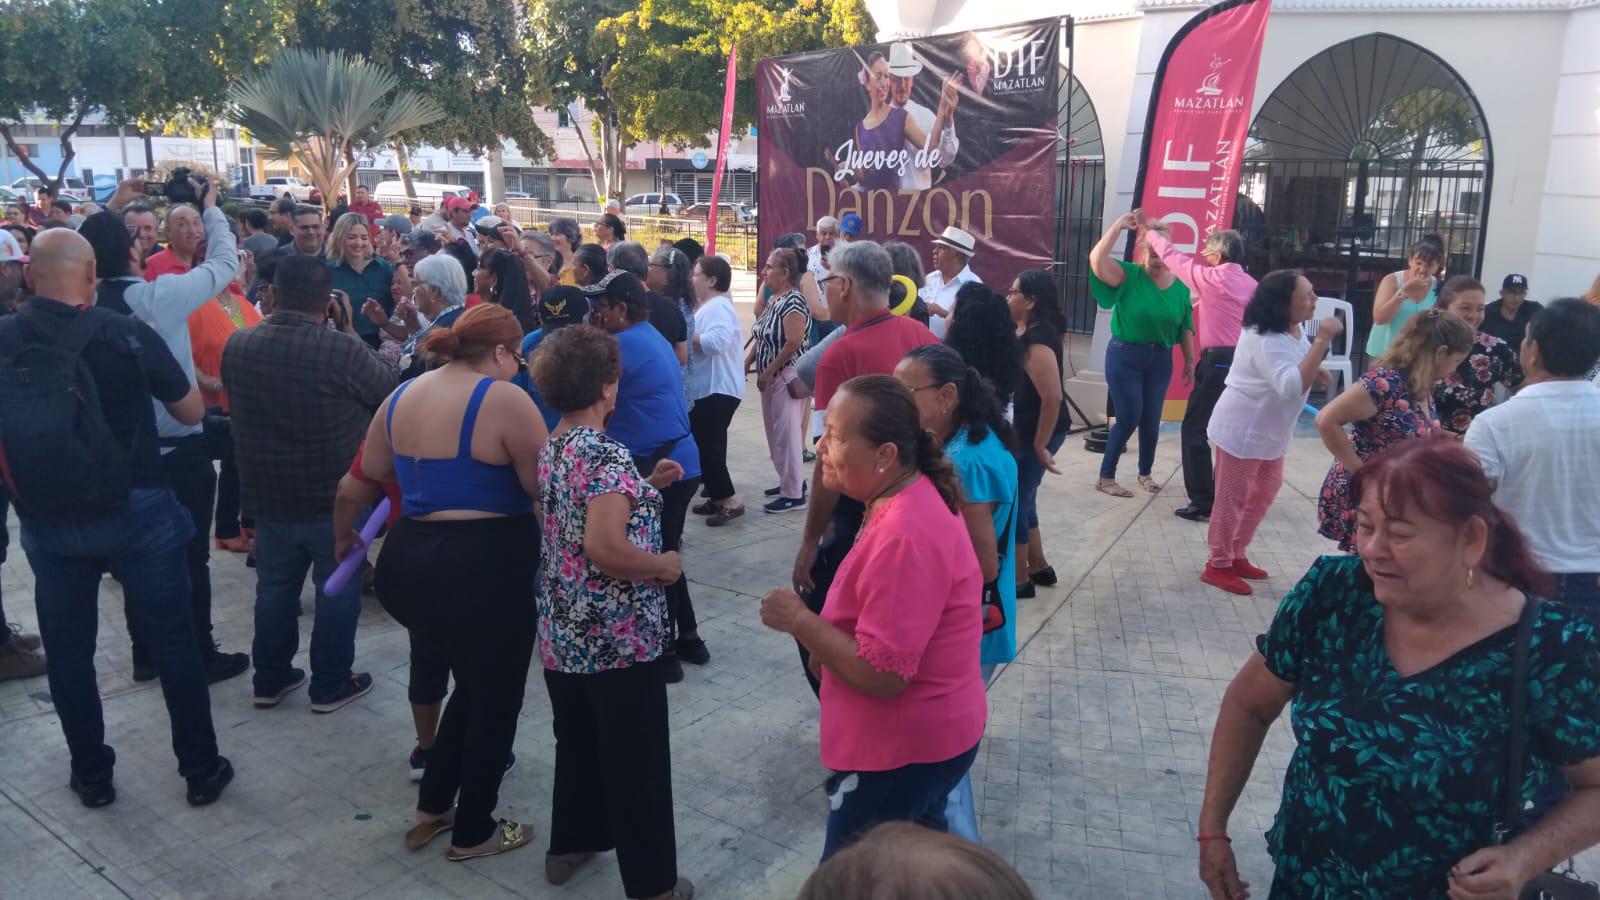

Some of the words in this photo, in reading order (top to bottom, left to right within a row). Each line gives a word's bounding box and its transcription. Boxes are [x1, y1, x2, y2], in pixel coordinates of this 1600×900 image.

[993, 40, 1045, 79] DIF
[833, 139, 911, 182] Jueves
[914, 132, 943, 169] de
[806, 166, 993, 241] Danzón
[1157, 140, 1211, 254] DIF
[1202, 140, 1232, 250] AZATLÁN
